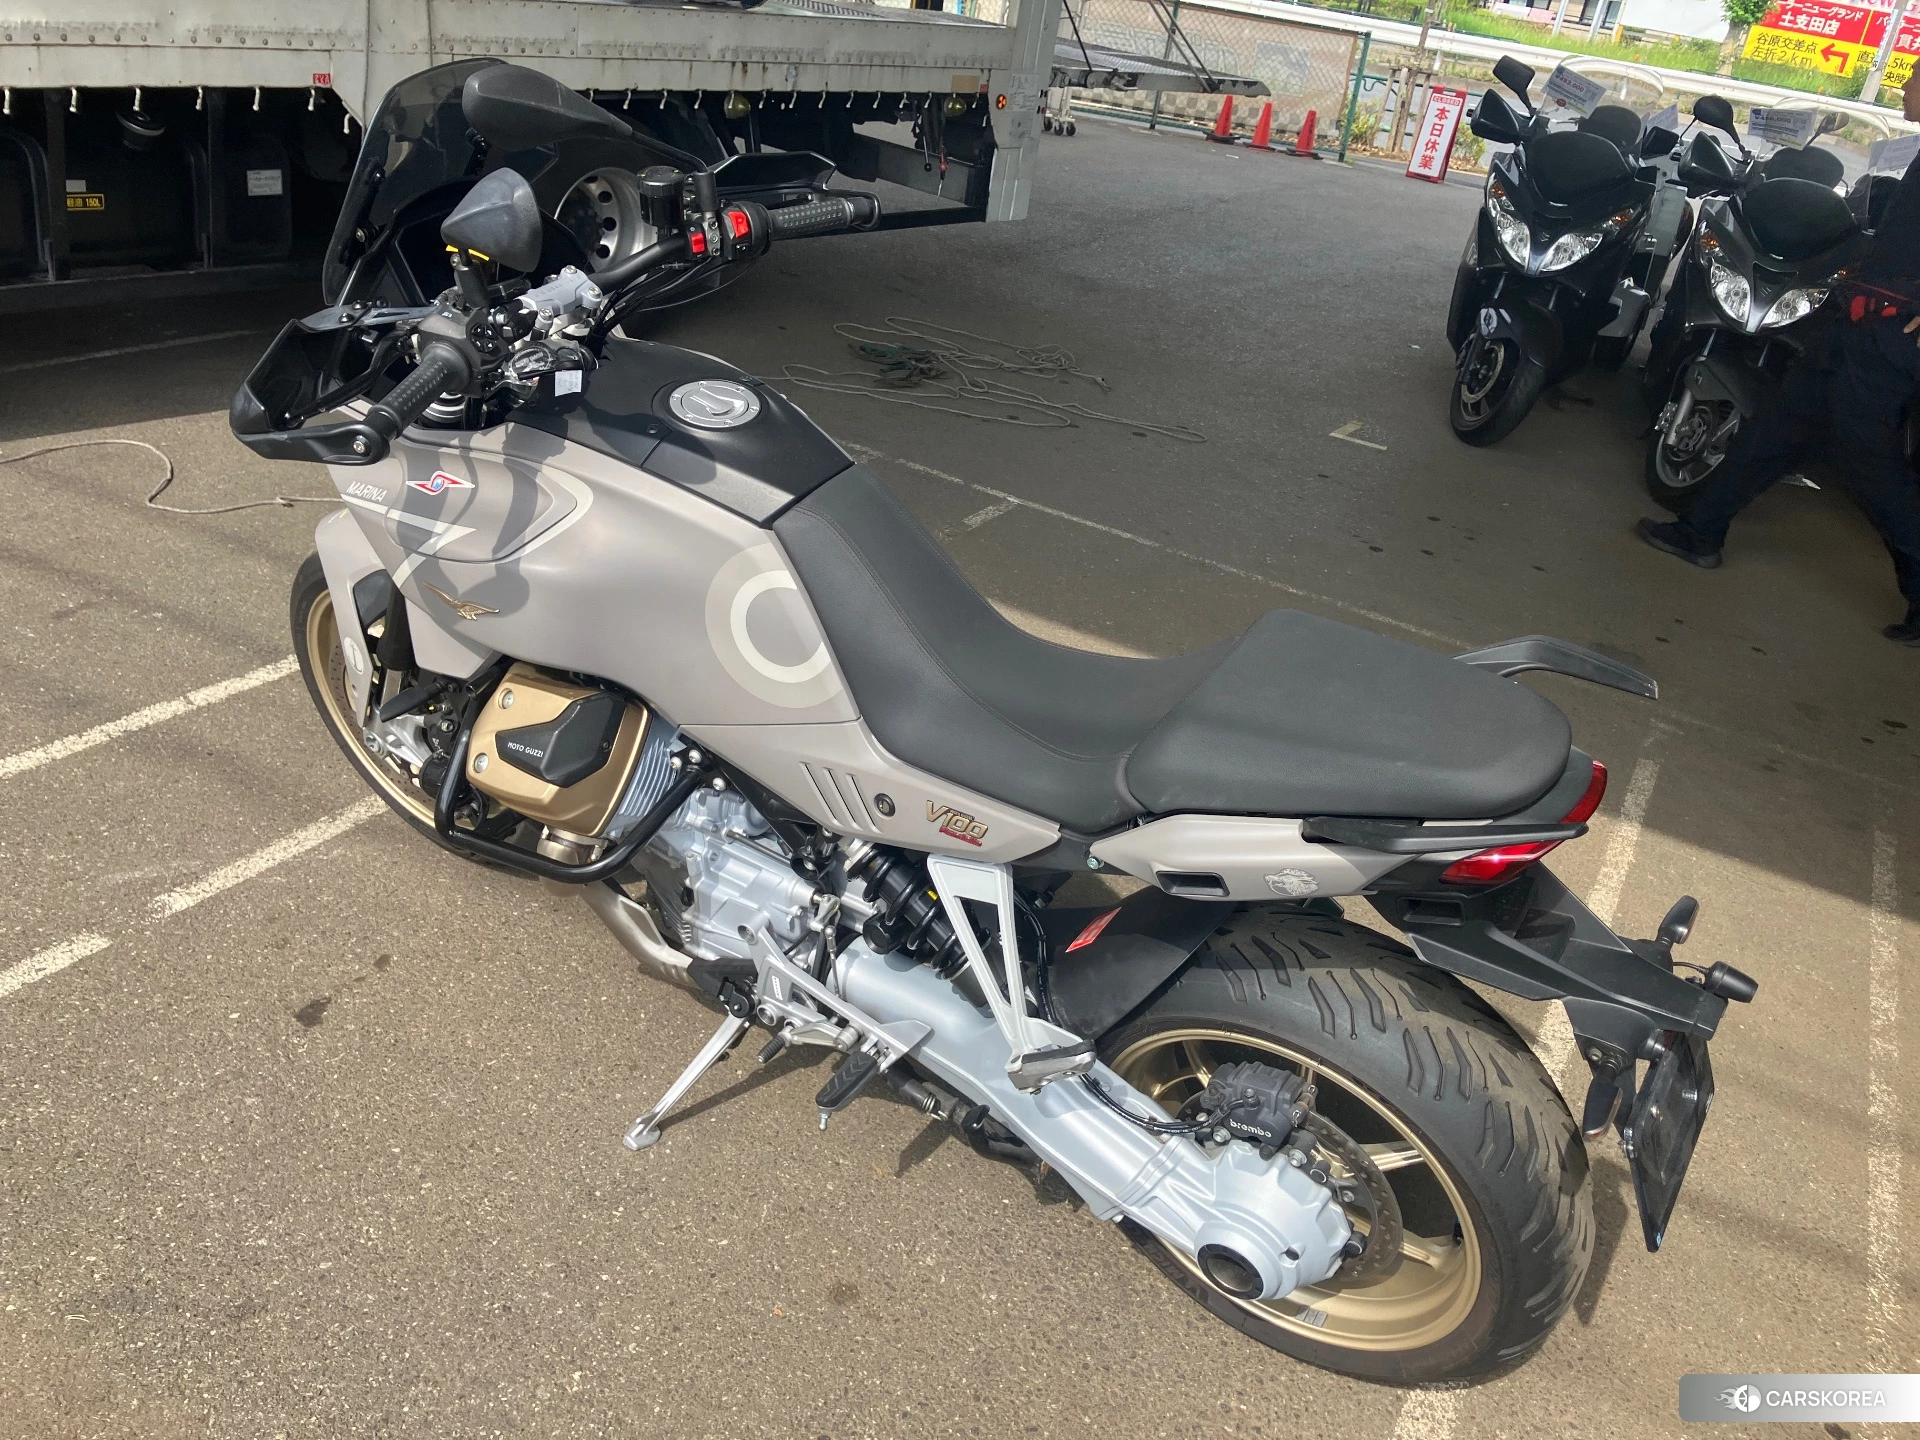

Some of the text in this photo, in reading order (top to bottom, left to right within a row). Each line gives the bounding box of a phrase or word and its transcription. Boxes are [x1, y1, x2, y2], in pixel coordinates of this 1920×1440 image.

[1778, 11, 1840, 36] 土支田店
[1757, 32, 1818, 55] 谷原交差点
[1433, 94, 1460, 106] CLOSED
[1418, 106, 1450, 171] 本日休業
[346, 480, 388, 503] MARINA
[507, 741, 544, 758] MOTO GUZZI
[926, 799, 989, 840] V100
[1229, 1118, 1272, 1138] brembo
